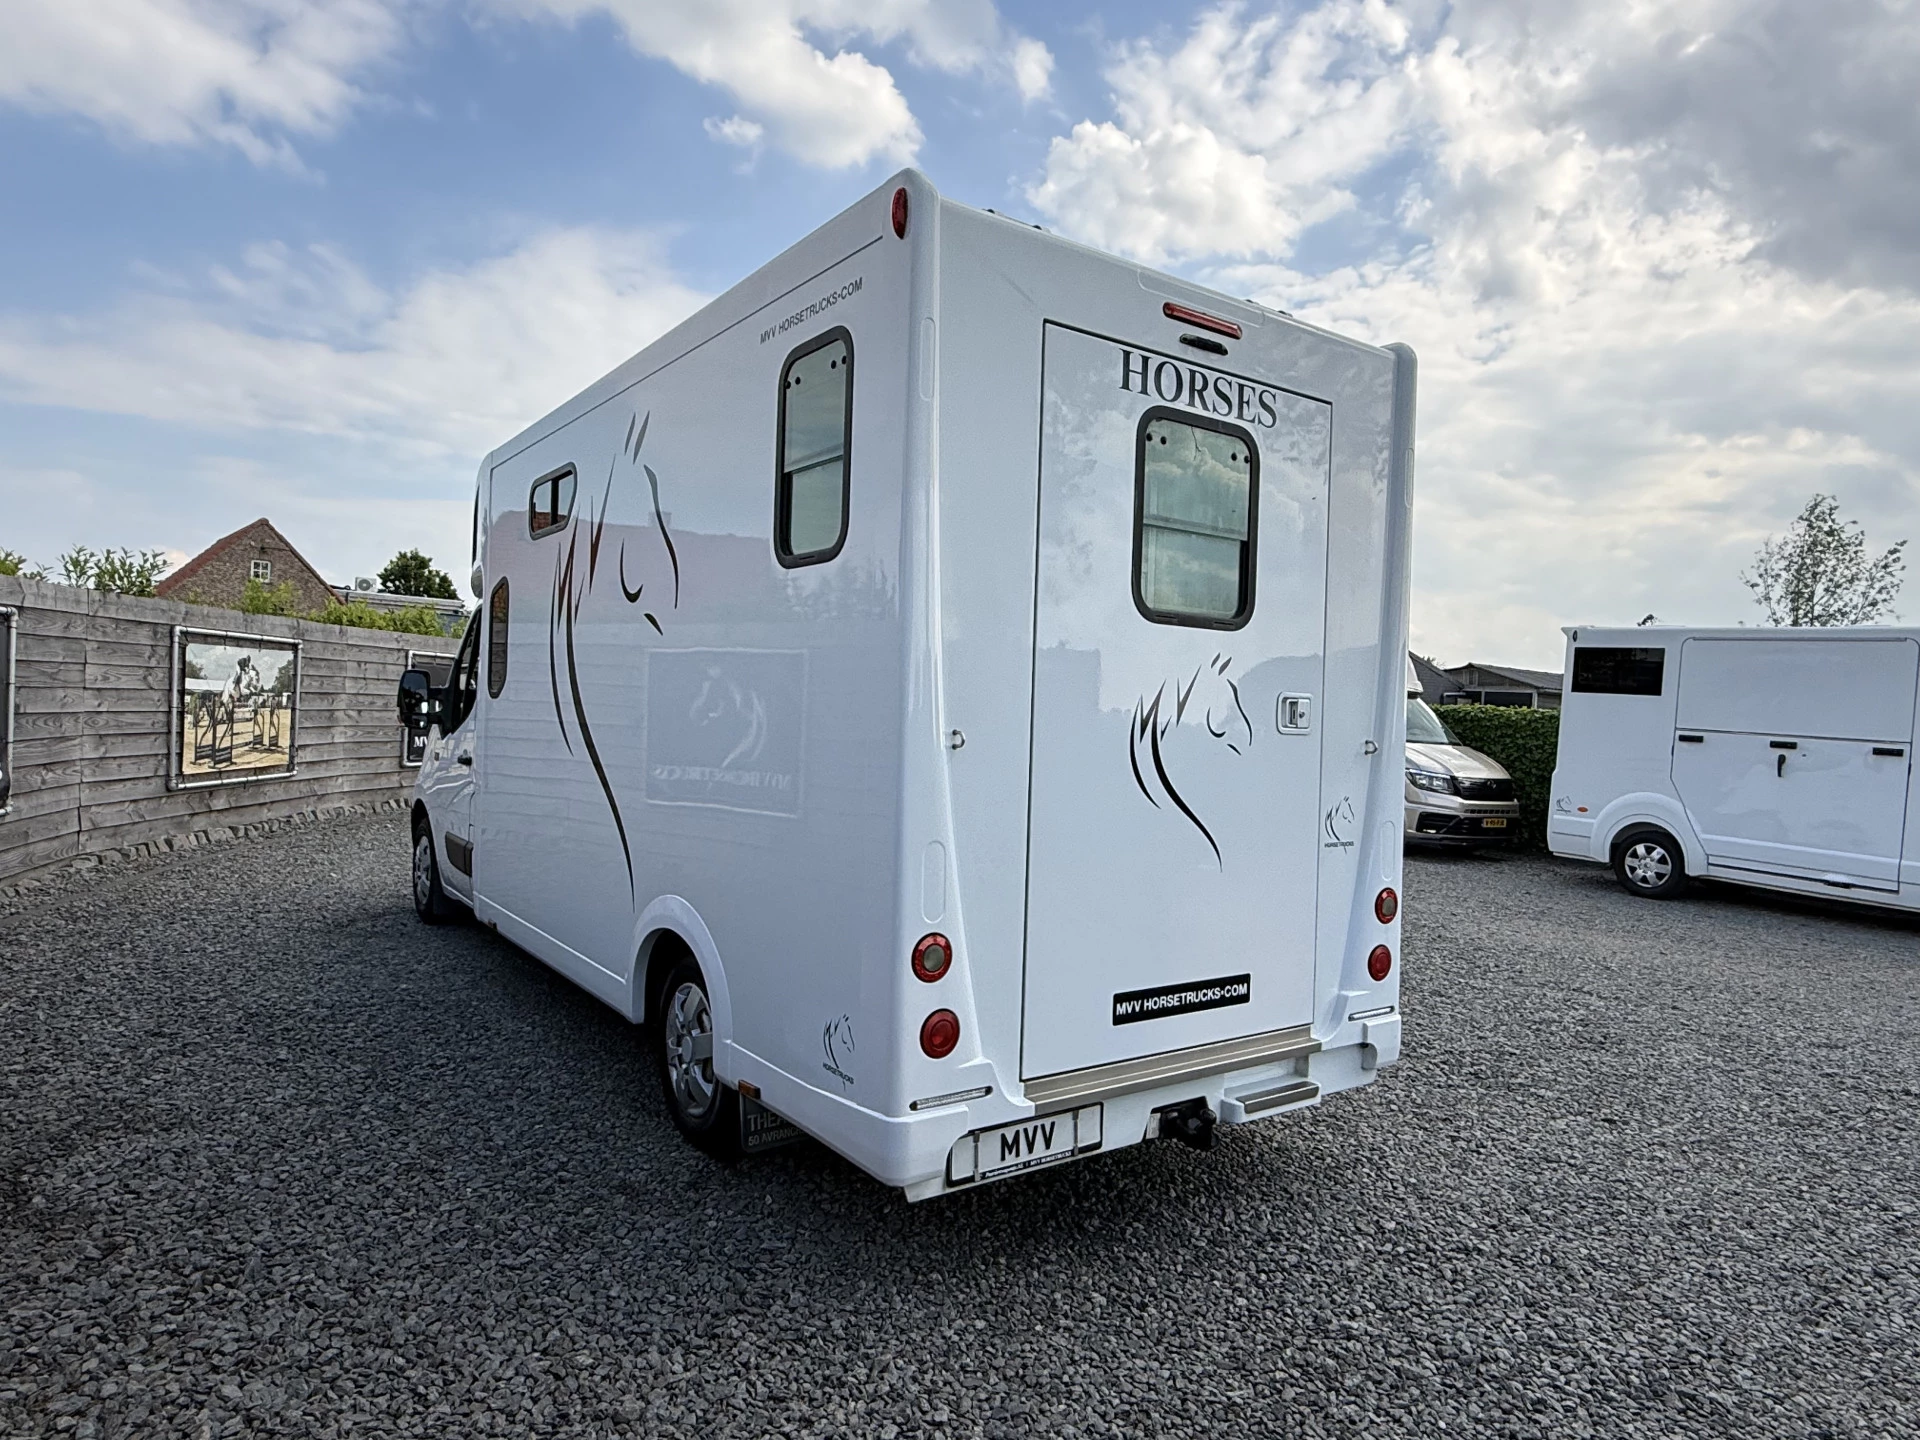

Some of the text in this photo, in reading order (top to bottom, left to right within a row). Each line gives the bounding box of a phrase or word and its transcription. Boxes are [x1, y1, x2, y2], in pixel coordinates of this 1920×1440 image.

[760, 325, 777, 345] MVV
[1118, 348, 1278, 429] HORSES
[1116, 999, 1142, 1016] MVV
[748, 1134, 760, 1146] 50
[999, 1120, 1057, 1162] MVV
